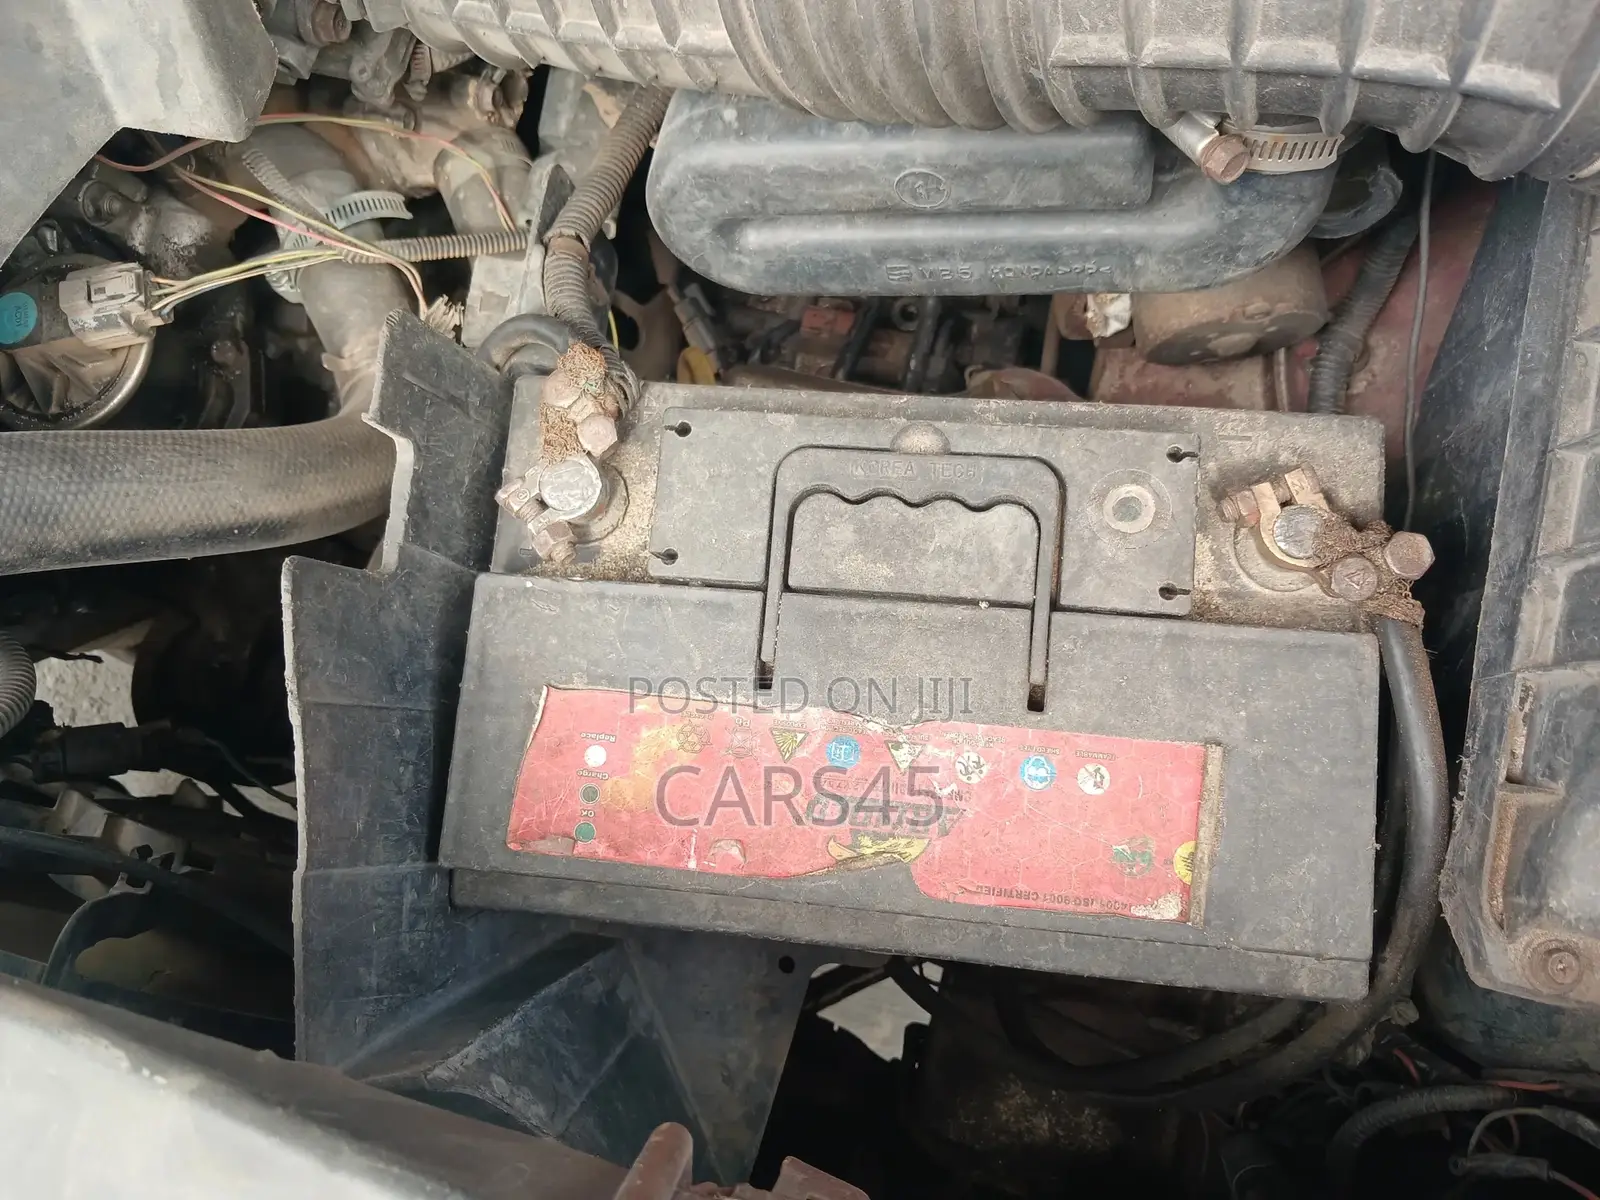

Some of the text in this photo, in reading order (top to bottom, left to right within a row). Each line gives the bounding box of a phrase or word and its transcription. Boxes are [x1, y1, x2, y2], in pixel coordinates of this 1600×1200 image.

[852, 460, 918, 478] KOREA
[734, 716, 751, 727] Pb
[579, 731, 616, 743] Replace
[576, 768, 609, 780] Charge
[579, 809, 595, 818] OK
[1042, 892, 1071, 906] 9001
